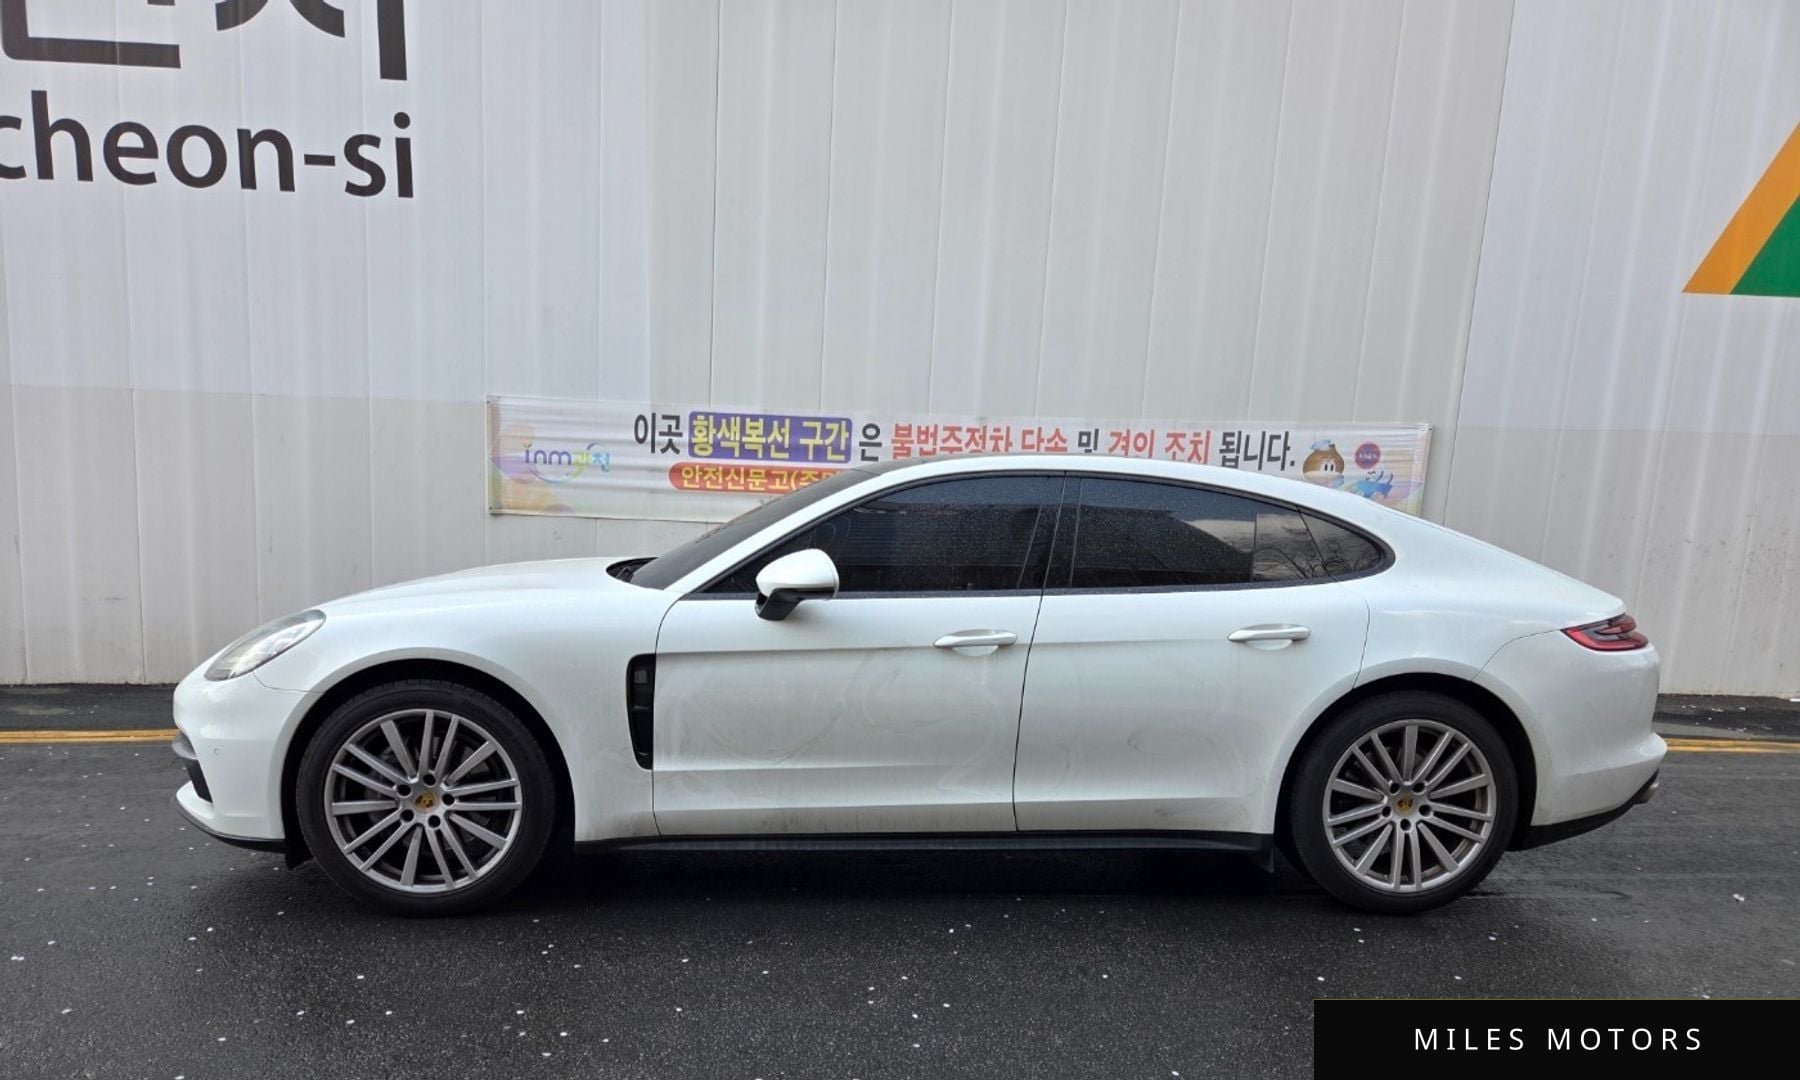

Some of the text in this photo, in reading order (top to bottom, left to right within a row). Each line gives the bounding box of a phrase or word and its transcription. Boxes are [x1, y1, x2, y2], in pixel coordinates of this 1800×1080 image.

[633, 411, 684, 455] 이곳
[691, 414, 791, 460] 황색복선
[799, 416, 849, 462] 구간
[858, 422, 883, 462] 은
[1164, 429, 1212, 465] 조치
[1218, 429, 1296, 472] 됩니다.
